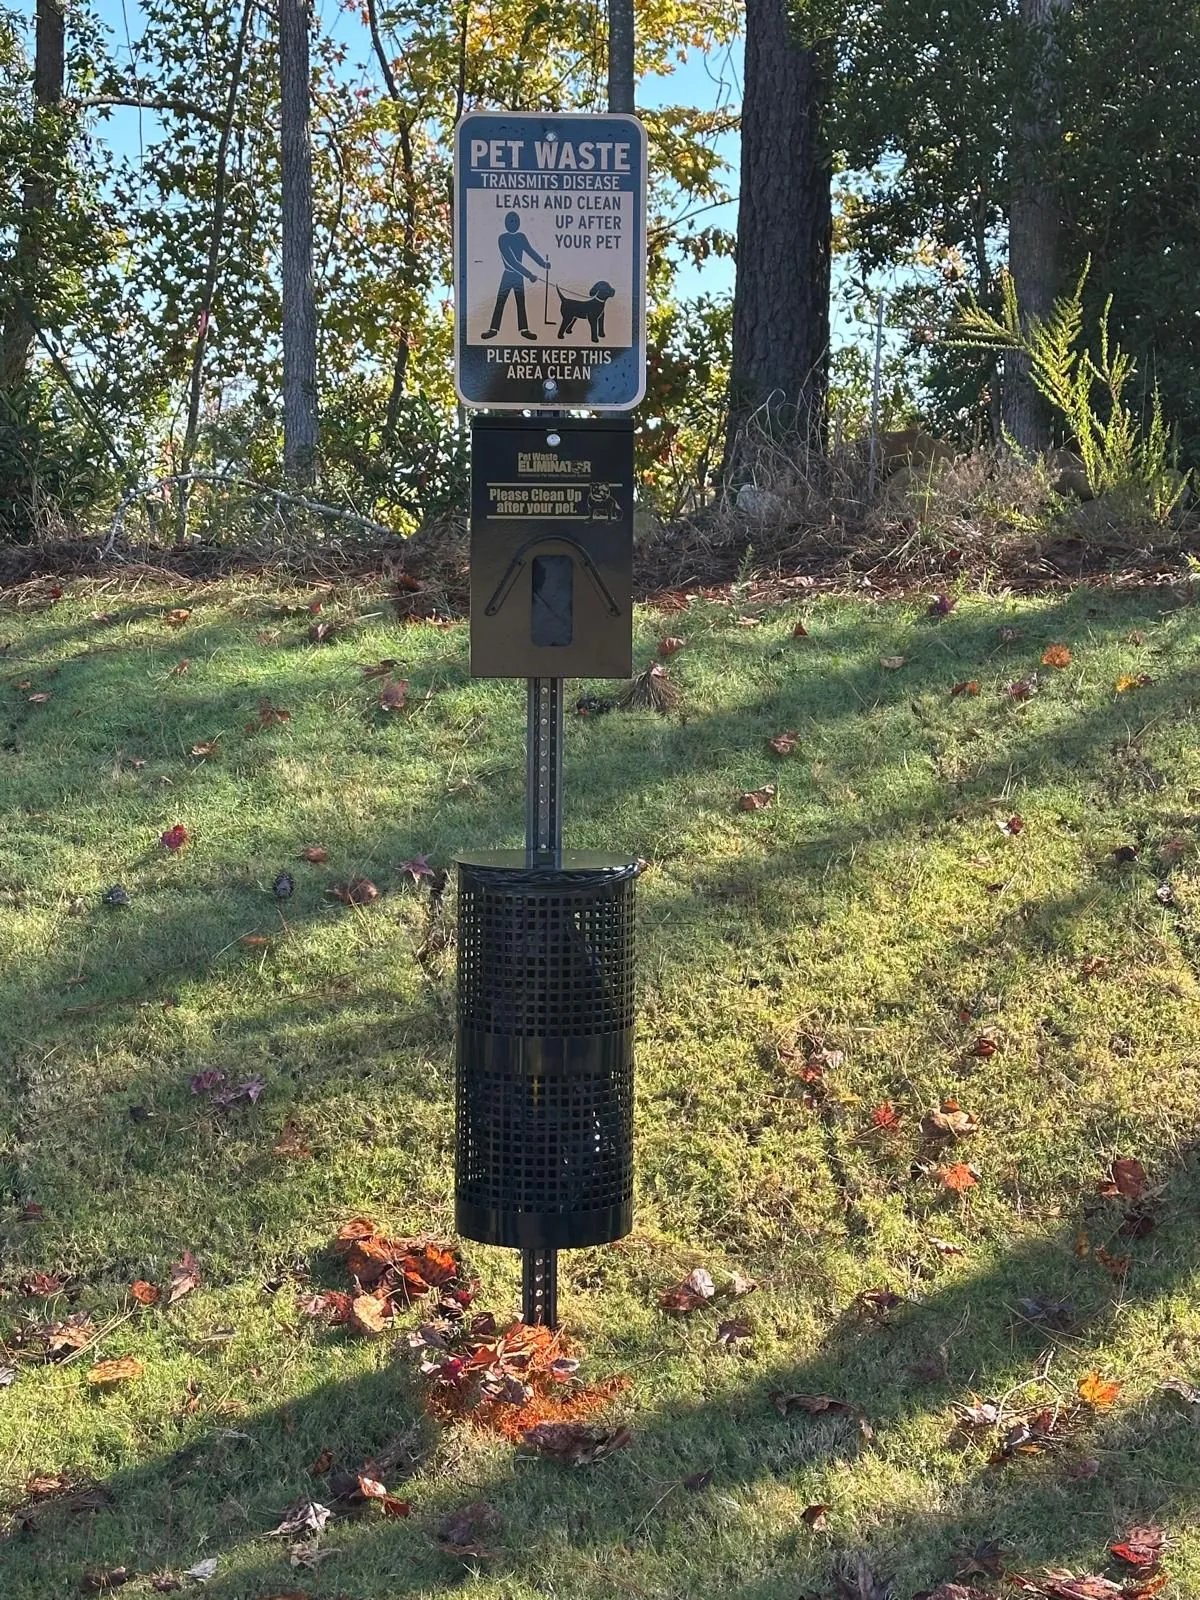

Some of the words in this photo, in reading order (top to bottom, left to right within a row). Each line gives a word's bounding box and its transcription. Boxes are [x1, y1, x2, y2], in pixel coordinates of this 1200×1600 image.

[471, 139, 524, 168] PET
[534, 141, 631, 170] WASTE
[481, 173, 558, 189] TRANSMITS
[563, 175, 620, 190] DISEASE
[496, 194, 539, 209] LEASH
[544, 195, 572, 210] AND
[577, 196, 621, 210] CLEAN
[555, 215, 573, 229] UP
[578, 215, 621, 230] AFTER
[555, 234, 592, 249] YOUR
[596, 235, 622, 249] PET
[487, 349, 538, 363] PLEASE
[542, 350, 577, 364] KEEP
[581, 350, 612, 364] THIS
[507, 365, 543, 379] AREA
[547, 365, 591, 380] CLEAN
[518, 452, 532, 461] Pet
[532, 452, 558, 461] Waste
[489, 489, 529, 501] Please
[531, 489, 566, 501] Clean
[567, 489, 582, 503] Up
[497, 502, 525, 513] after
[527, 503, 551, 514] your
[555, 503, 577, 514] pet.
